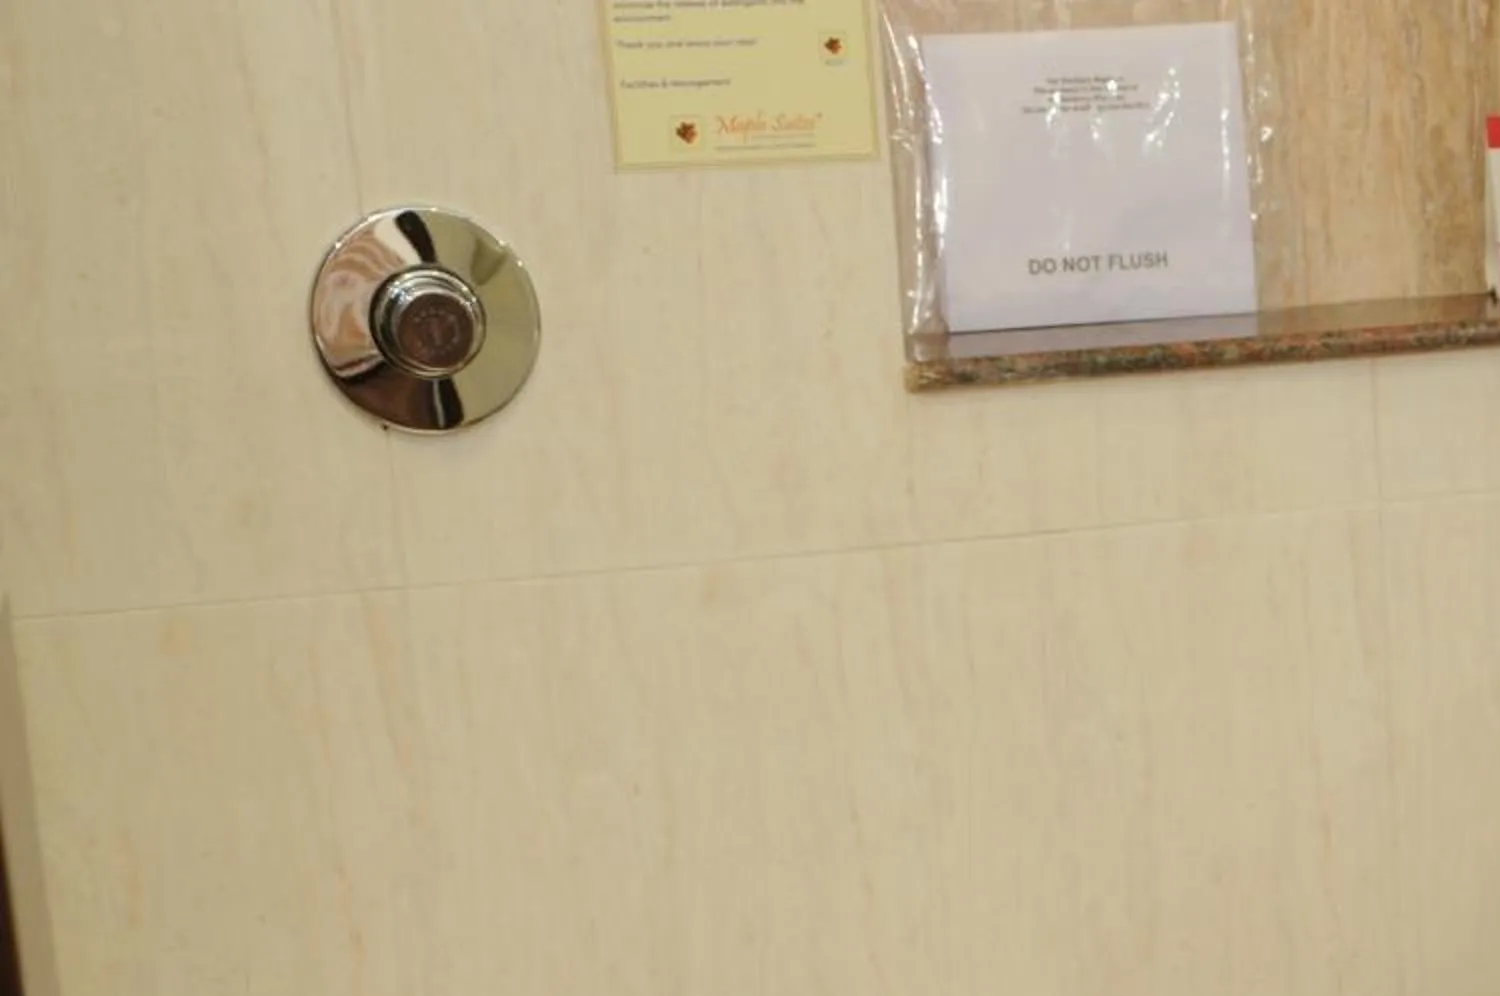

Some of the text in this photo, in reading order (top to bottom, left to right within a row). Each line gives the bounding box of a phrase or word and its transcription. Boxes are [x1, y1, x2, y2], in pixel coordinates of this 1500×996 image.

[1027, 250, 1169, 276] DO NOT FLUSH
